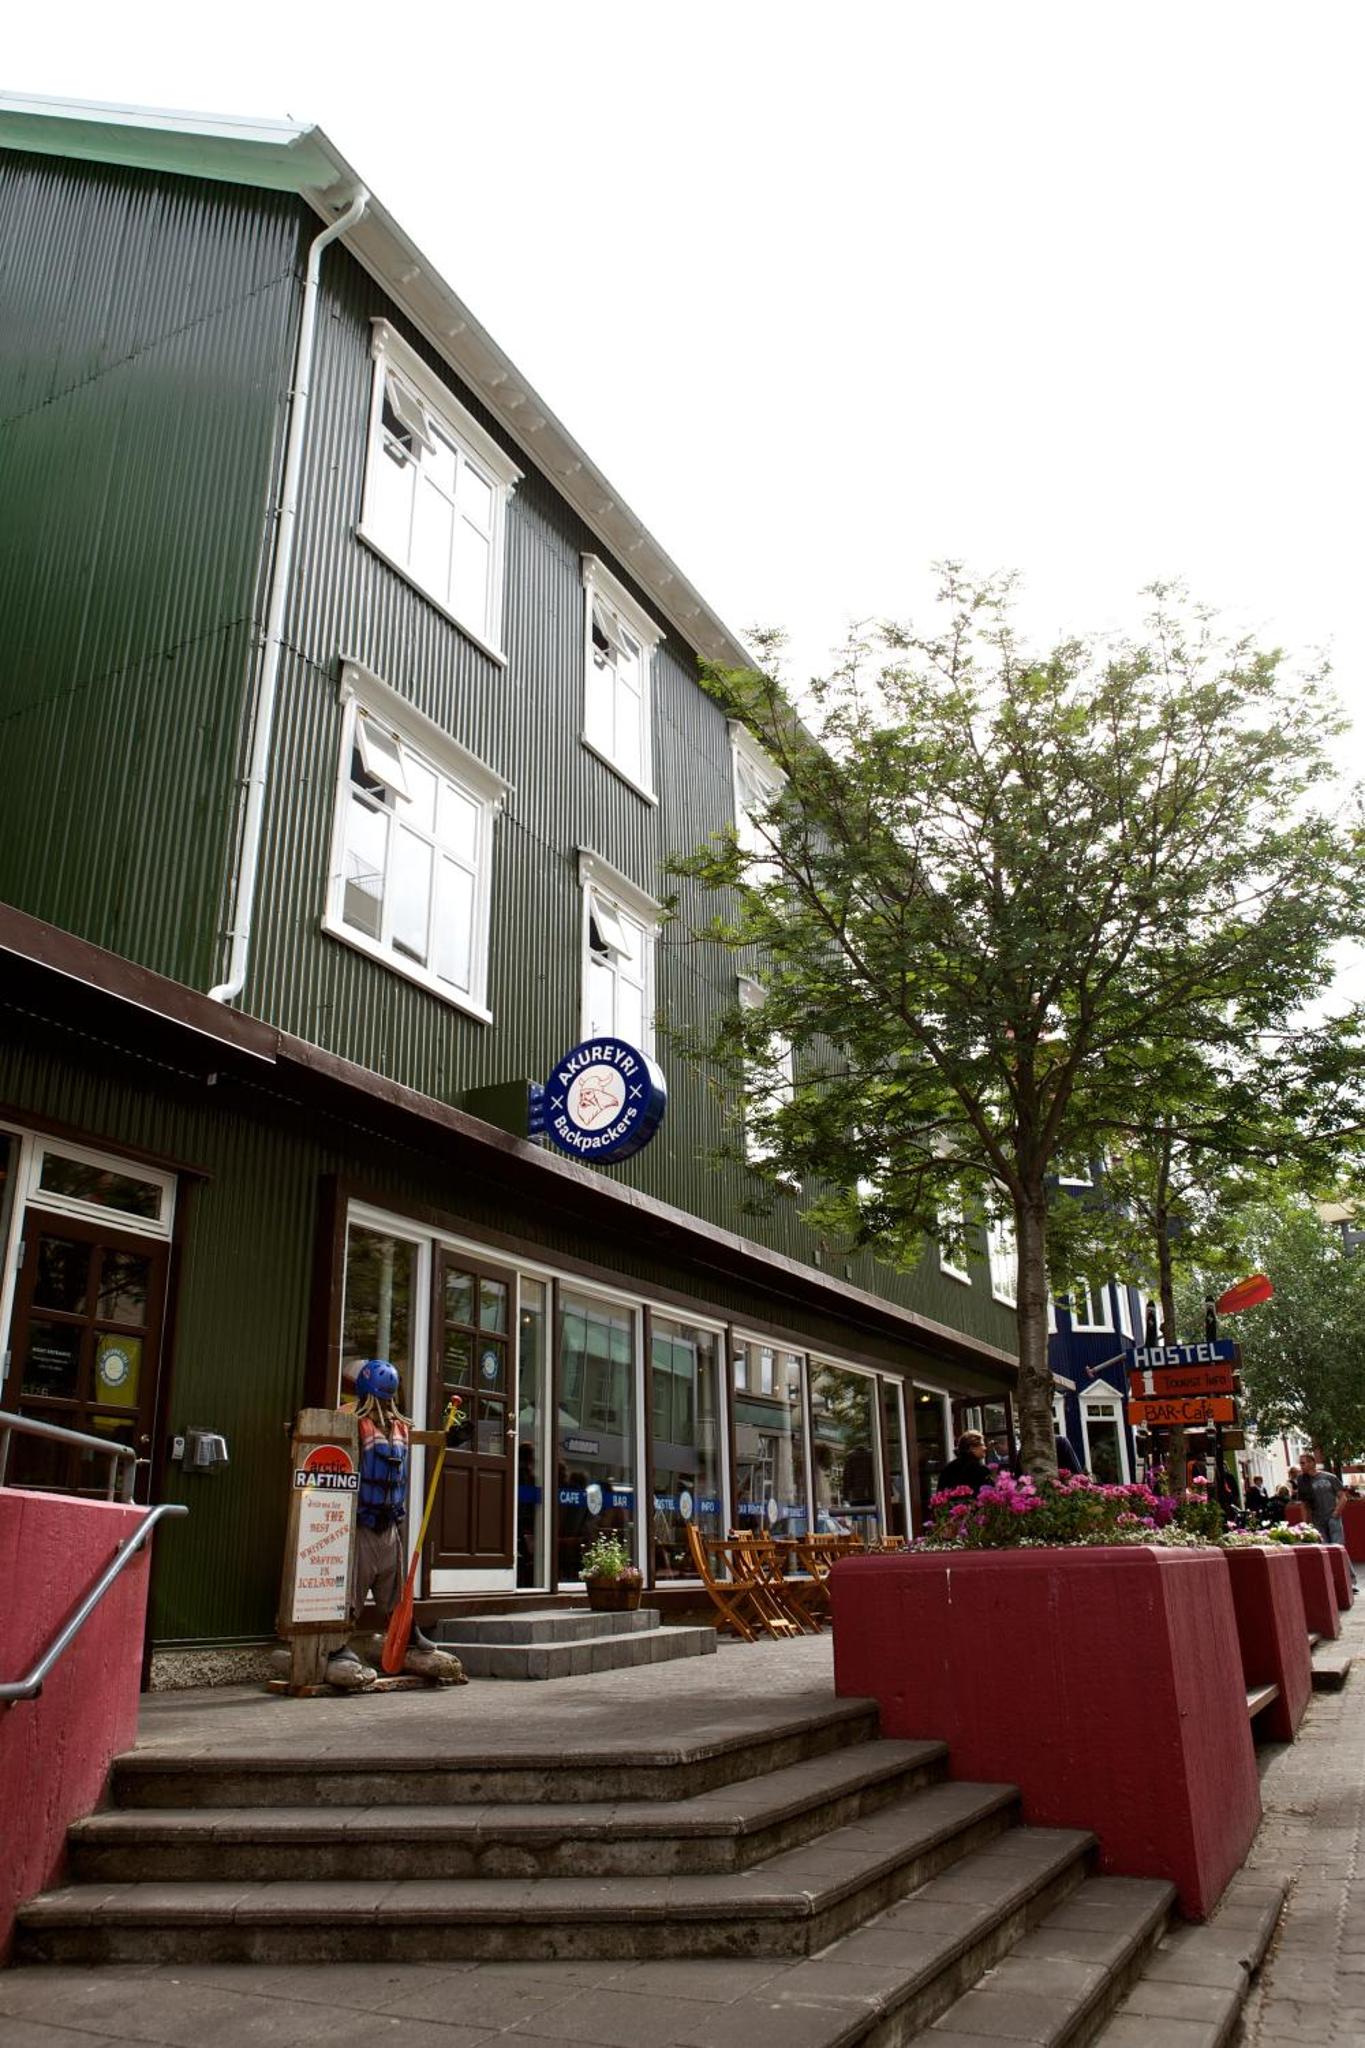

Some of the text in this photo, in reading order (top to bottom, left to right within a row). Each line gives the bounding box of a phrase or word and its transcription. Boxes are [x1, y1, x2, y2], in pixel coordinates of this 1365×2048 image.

[558, 1045, 639, 1086] AKUREYRI
[554, 1107, 637, 1152] Backpackers
[1133, 1342, 1224, 1367] HOSTEL
[296, 1473, 357, 1489] RAFTING
[612, 1495, 628, 1507] BAR
[324, 1510, 345, 1522] THE
